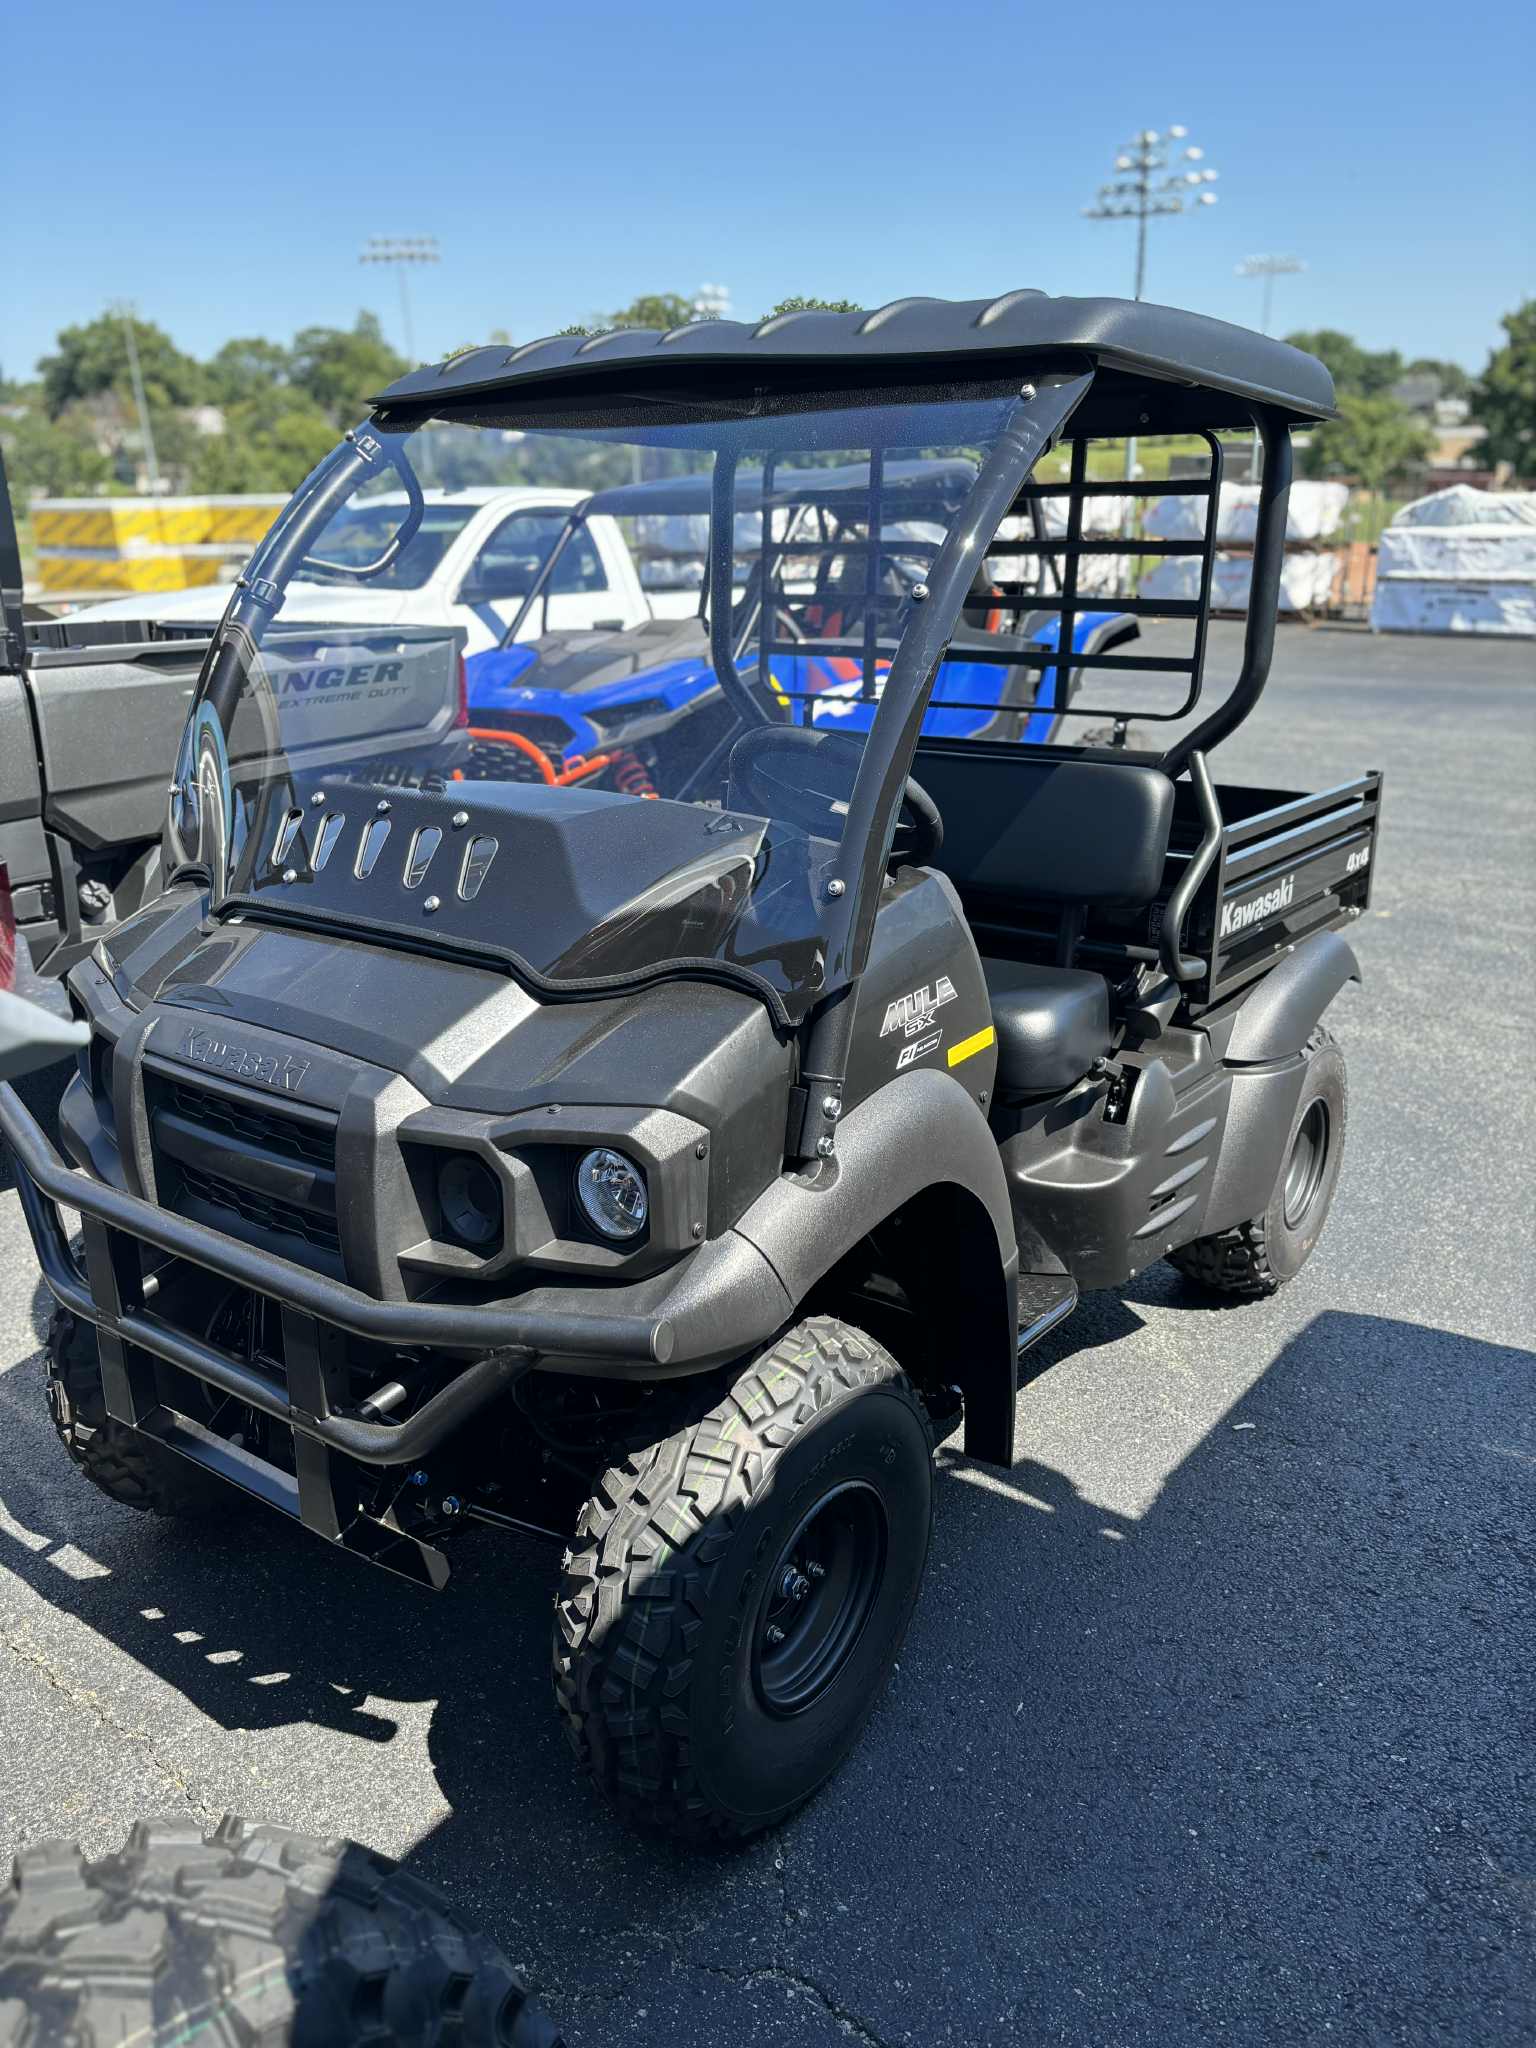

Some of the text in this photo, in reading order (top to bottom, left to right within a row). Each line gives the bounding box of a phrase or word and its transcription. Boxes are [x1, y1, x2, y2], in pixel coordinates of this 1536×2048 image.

[277, 686, 410, 710] EXTREME DUTY
[1346, 847, 1370, 873] 4x4
[1219, 875, 1295, 937] Kawasaki
[880, 976, 959, 1037] MULE
[904, 1009, 937, 1037] SX
[177, 1026, 311, 1091] Kawasaki
